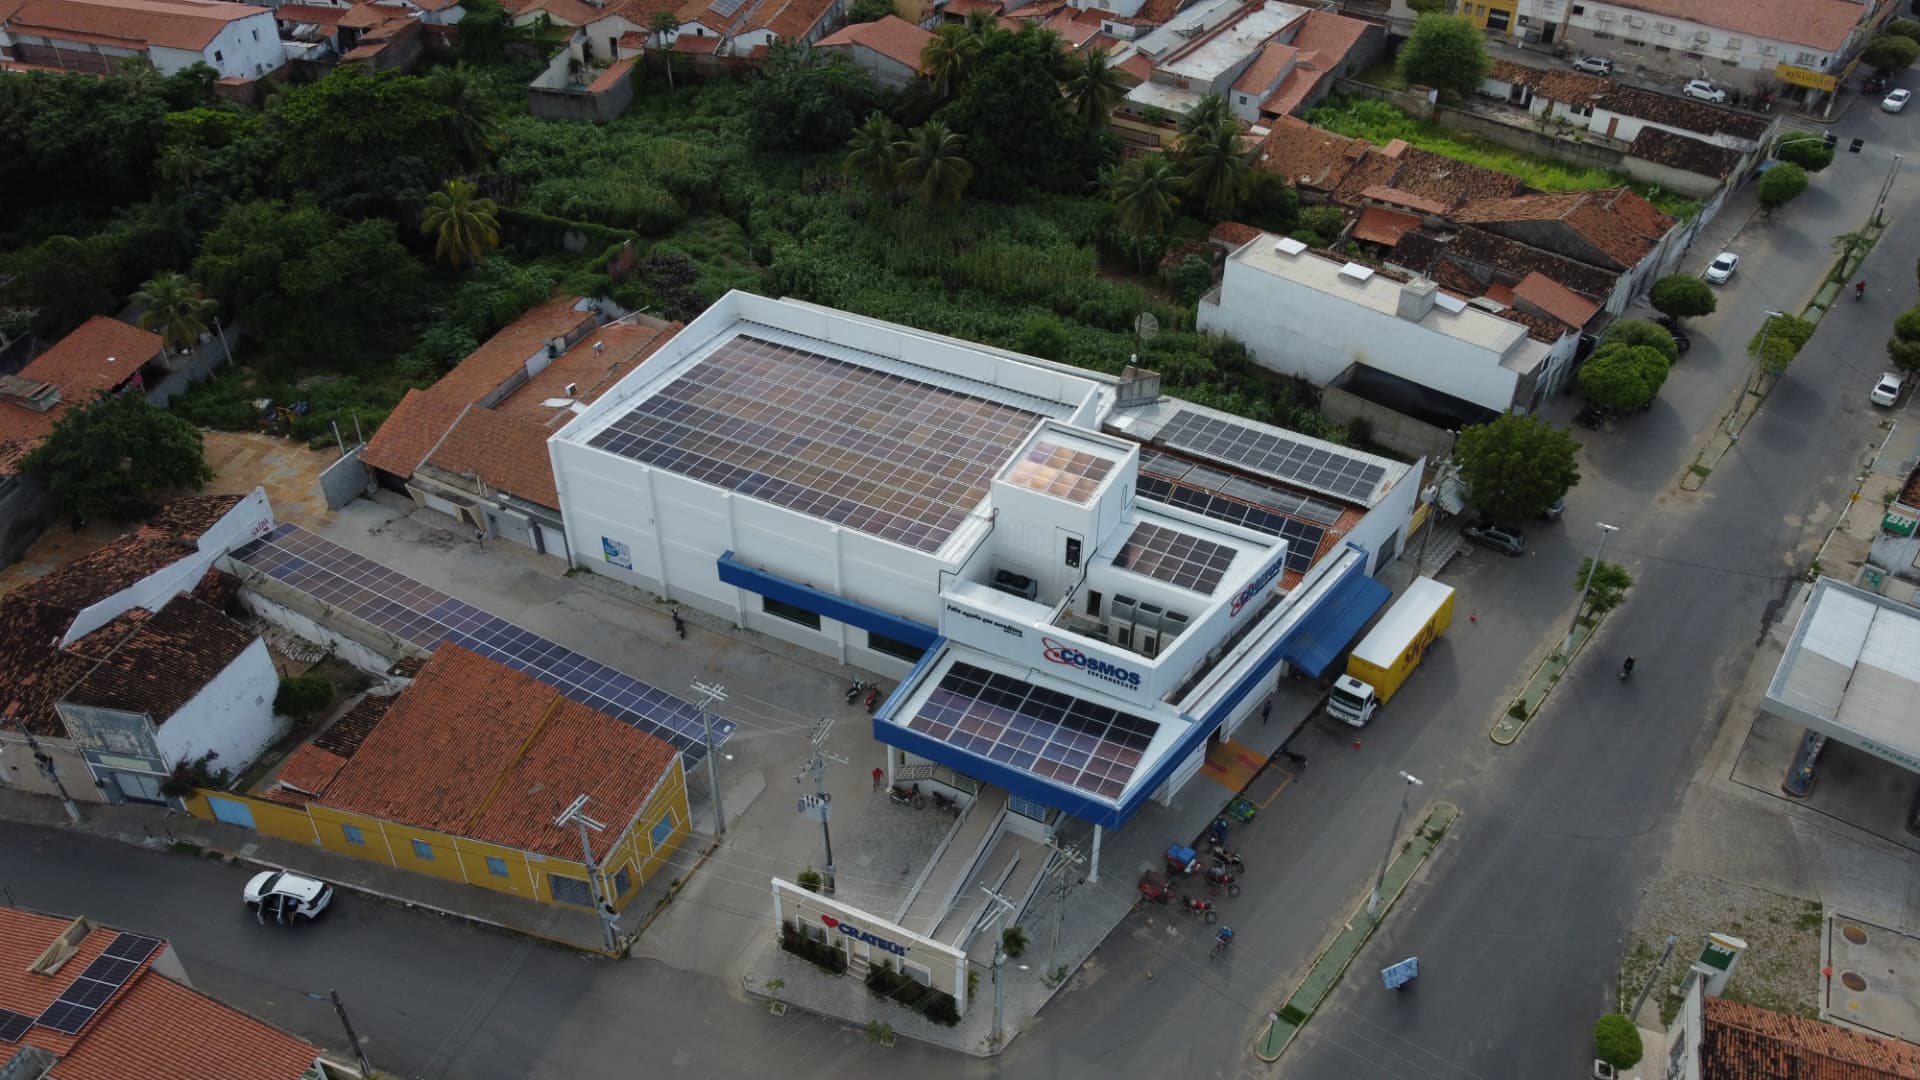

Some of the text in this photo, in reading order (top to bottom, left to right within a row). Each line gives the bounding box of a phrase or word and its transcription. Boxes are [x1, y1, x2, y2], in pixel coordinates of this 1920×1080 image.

[1060, 649, 1141, 686] COSMOS
[1087, 670, 1138, 691] SUPERMERCADO
[1861, 741, 1920, 769] PETROBRA
